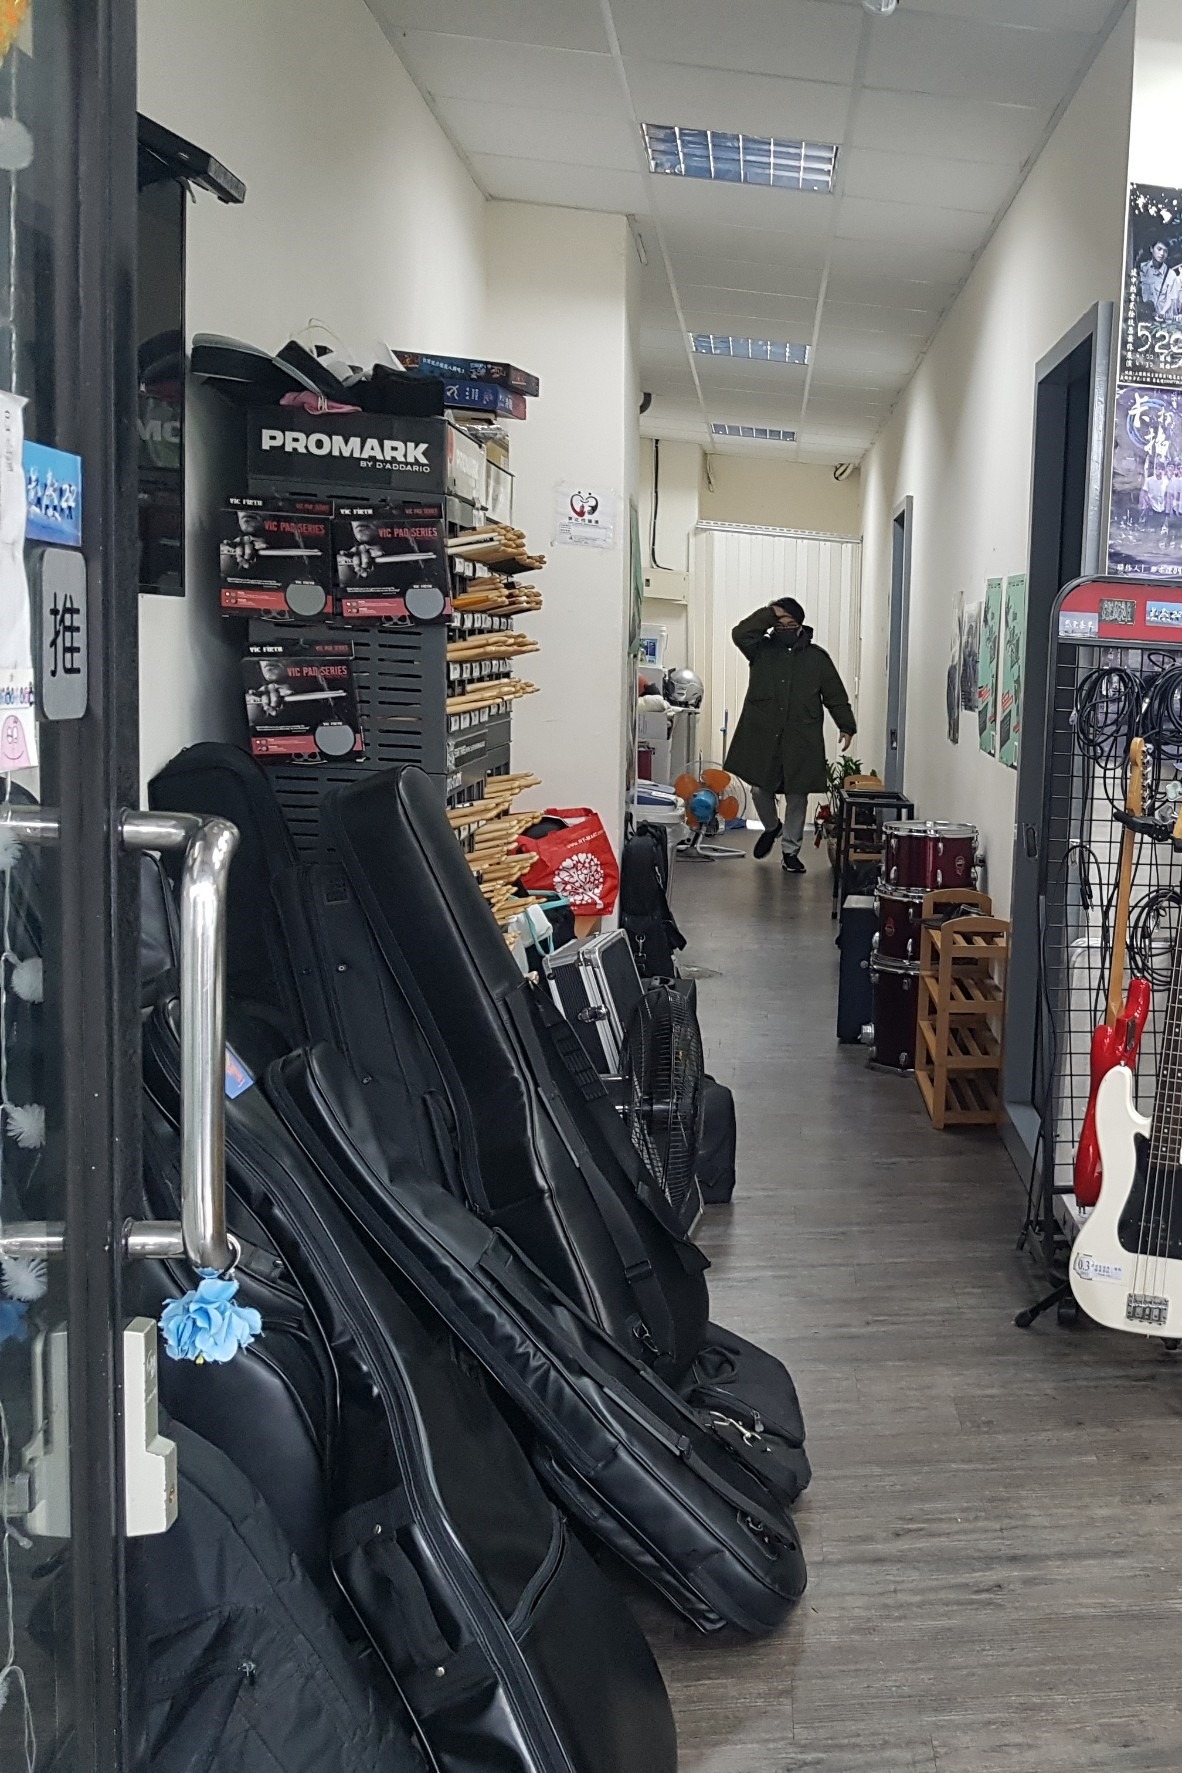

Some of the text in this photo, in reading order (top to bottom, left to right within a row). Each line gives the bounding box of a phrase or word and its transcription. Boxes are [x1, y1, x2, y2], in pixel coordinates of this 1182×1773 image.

[261, 429, 430, 464] PROMARK
[376, 462, 430, 473] D'ADDARIO
[264, 521, 325, 535] VIC PAD SERIES
[378, 527, 437, 537] VIC PAD SERIES
[50, 592, 81, 677] 推
[287, 665, 347, 677] VIC PAD SERIES
[1078, 1260, 1089, 1271] 0.3
